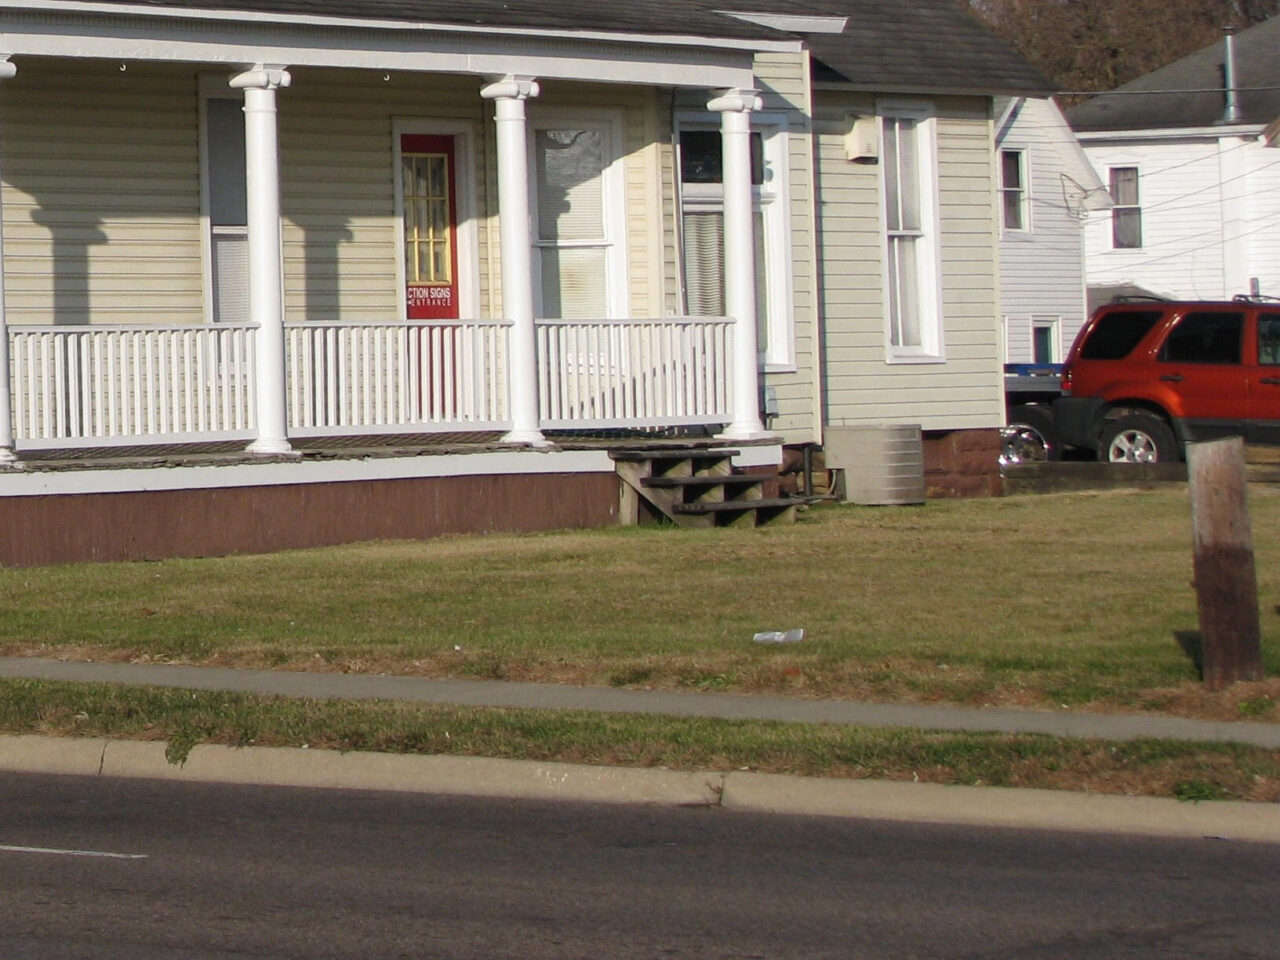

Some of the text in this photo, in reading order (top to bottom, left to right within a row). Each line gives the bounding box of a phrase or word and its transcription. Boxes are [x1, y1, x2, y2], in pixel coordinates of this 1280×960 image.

[408, 287, 451, 298] CTION SIGNS
[411, 298, 451, 307] ENTRANCE
